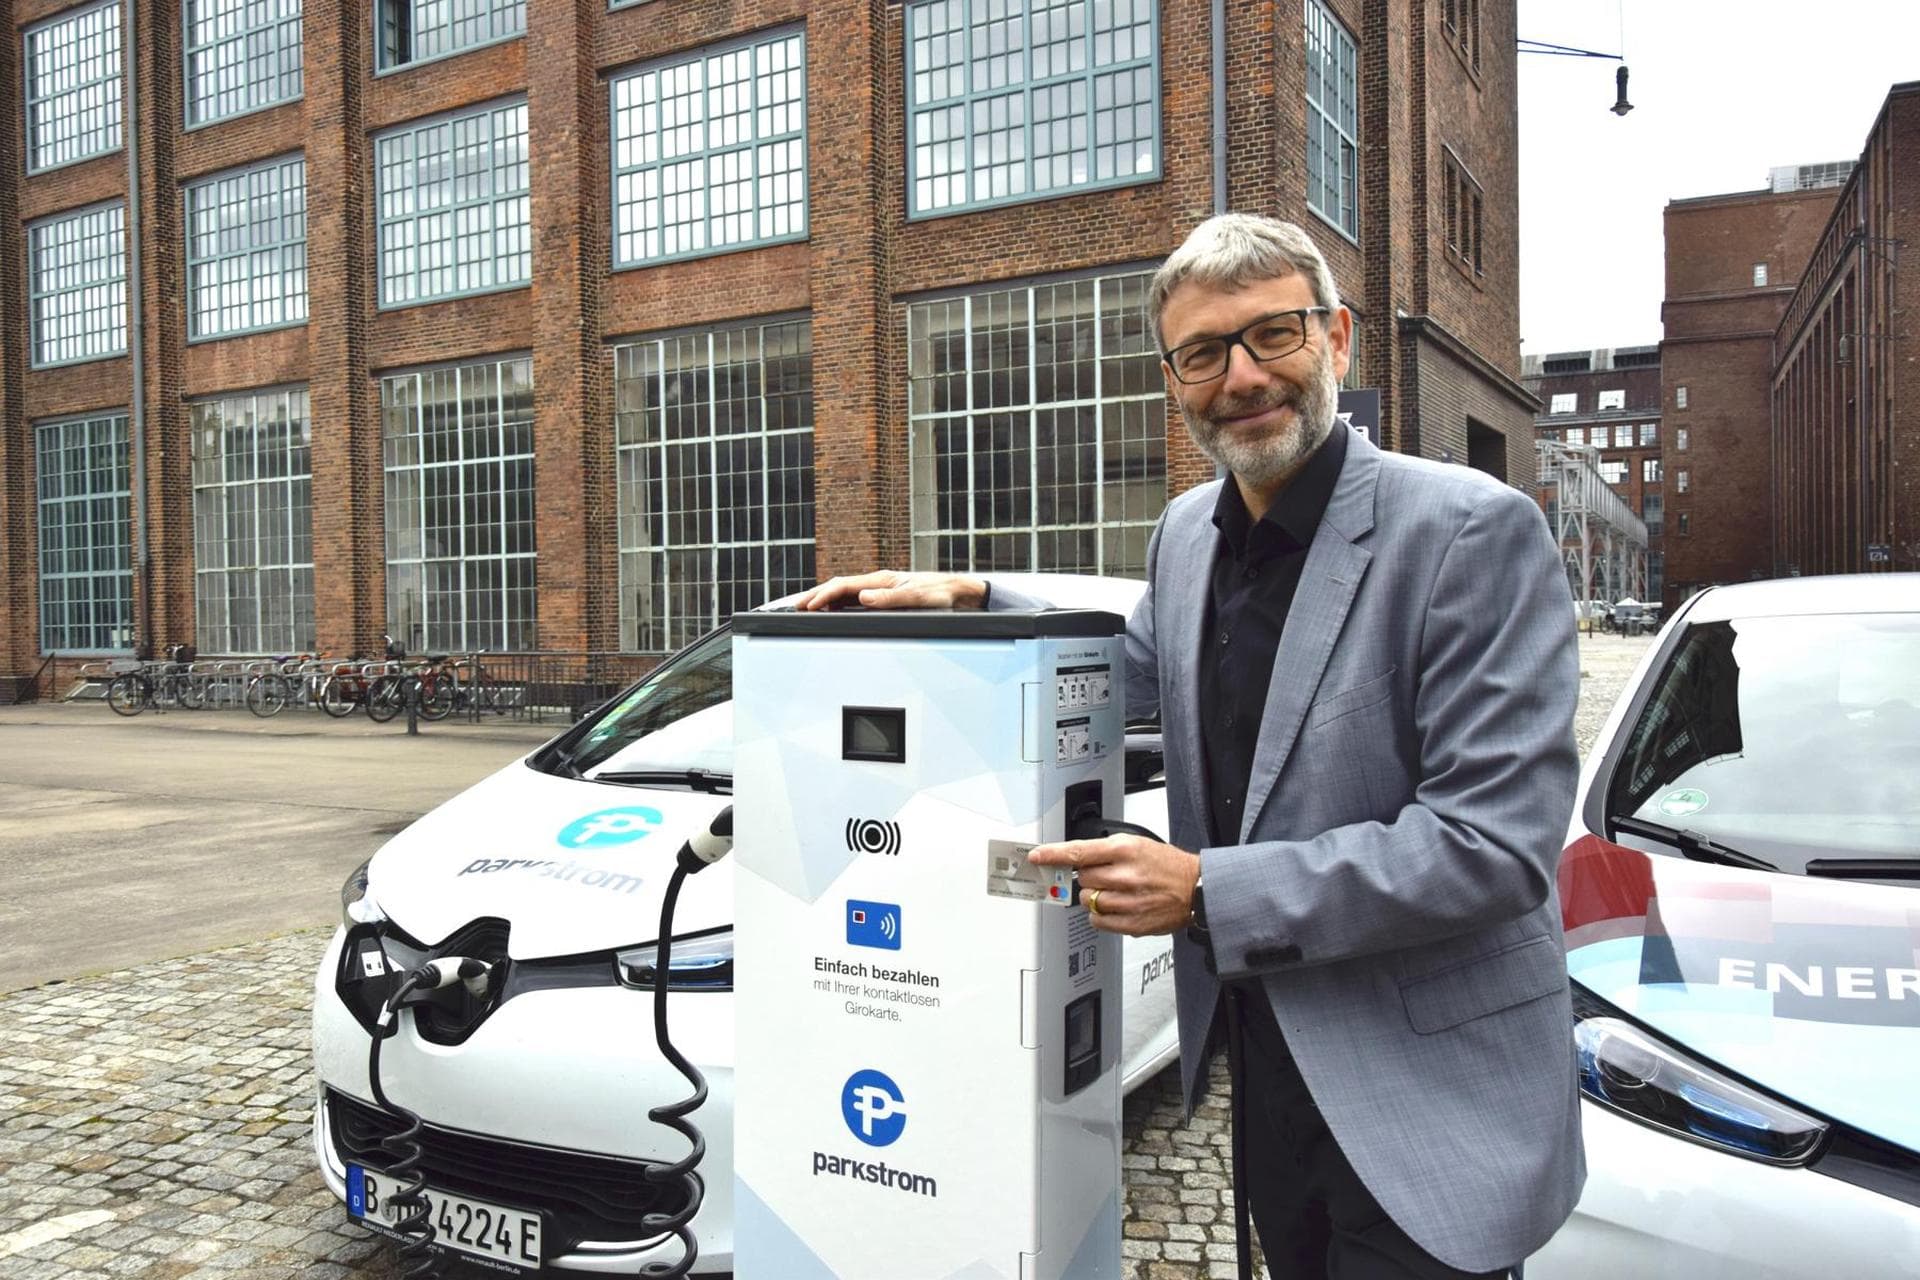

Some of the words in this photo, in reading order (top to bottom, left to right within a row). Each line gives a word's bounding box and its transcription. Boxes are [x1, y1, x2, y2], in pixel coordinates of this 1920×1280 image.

[814, 956, 868, 978] Einfach
[871, 964, 940, 988] bezahlen
[1718, 956, 1920, 1001] ENER
[813, 979, 831, 992] mit
[834, 980, 861, 996] Ihrer
[863, 984, 941, 1008] kontaktlosen
[844, 1000, 902, 1022] Girokarte.
[813, 1151, 937, 1198] parkstrom
[364, 1174, 379, 1214] B
